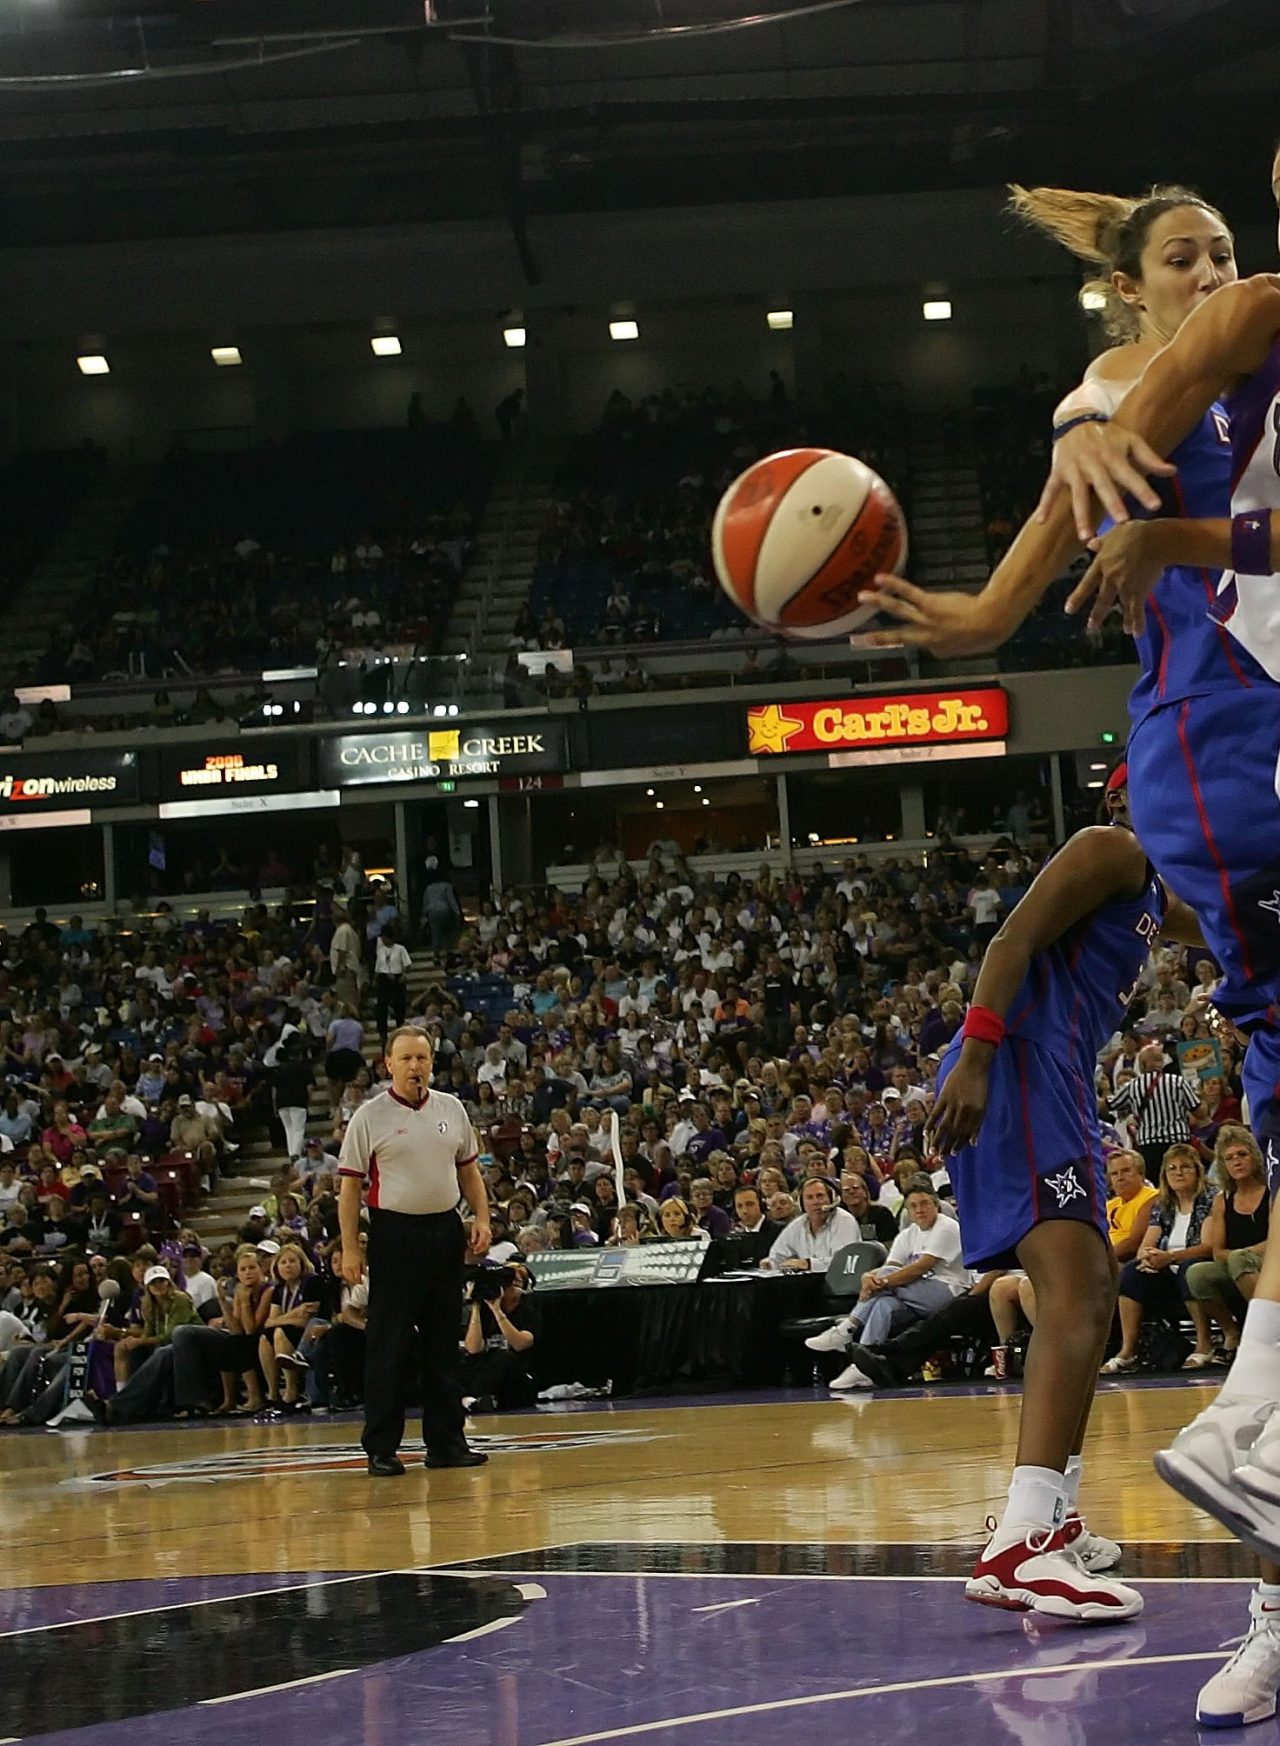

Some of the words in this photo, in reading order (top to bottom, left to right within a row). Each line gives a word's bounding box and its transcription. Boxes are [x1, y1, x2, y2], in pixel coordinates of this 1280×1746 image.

[812, 704, 931, 742] Carl's
[932, 699, 988, 733] Jr.
[341, 743, 424, 765] CACHE
[463, 735, 545, 757] CREEK
[205, 754, 244, 770] 2006
[388, 764, 441, 779] CASINO
[450, 761, 500, 776] RESORT
[225, 764, 278, 783] FINALS
[55, 776, 116, 793] wireless
[519, 776, 542, 790] 124
